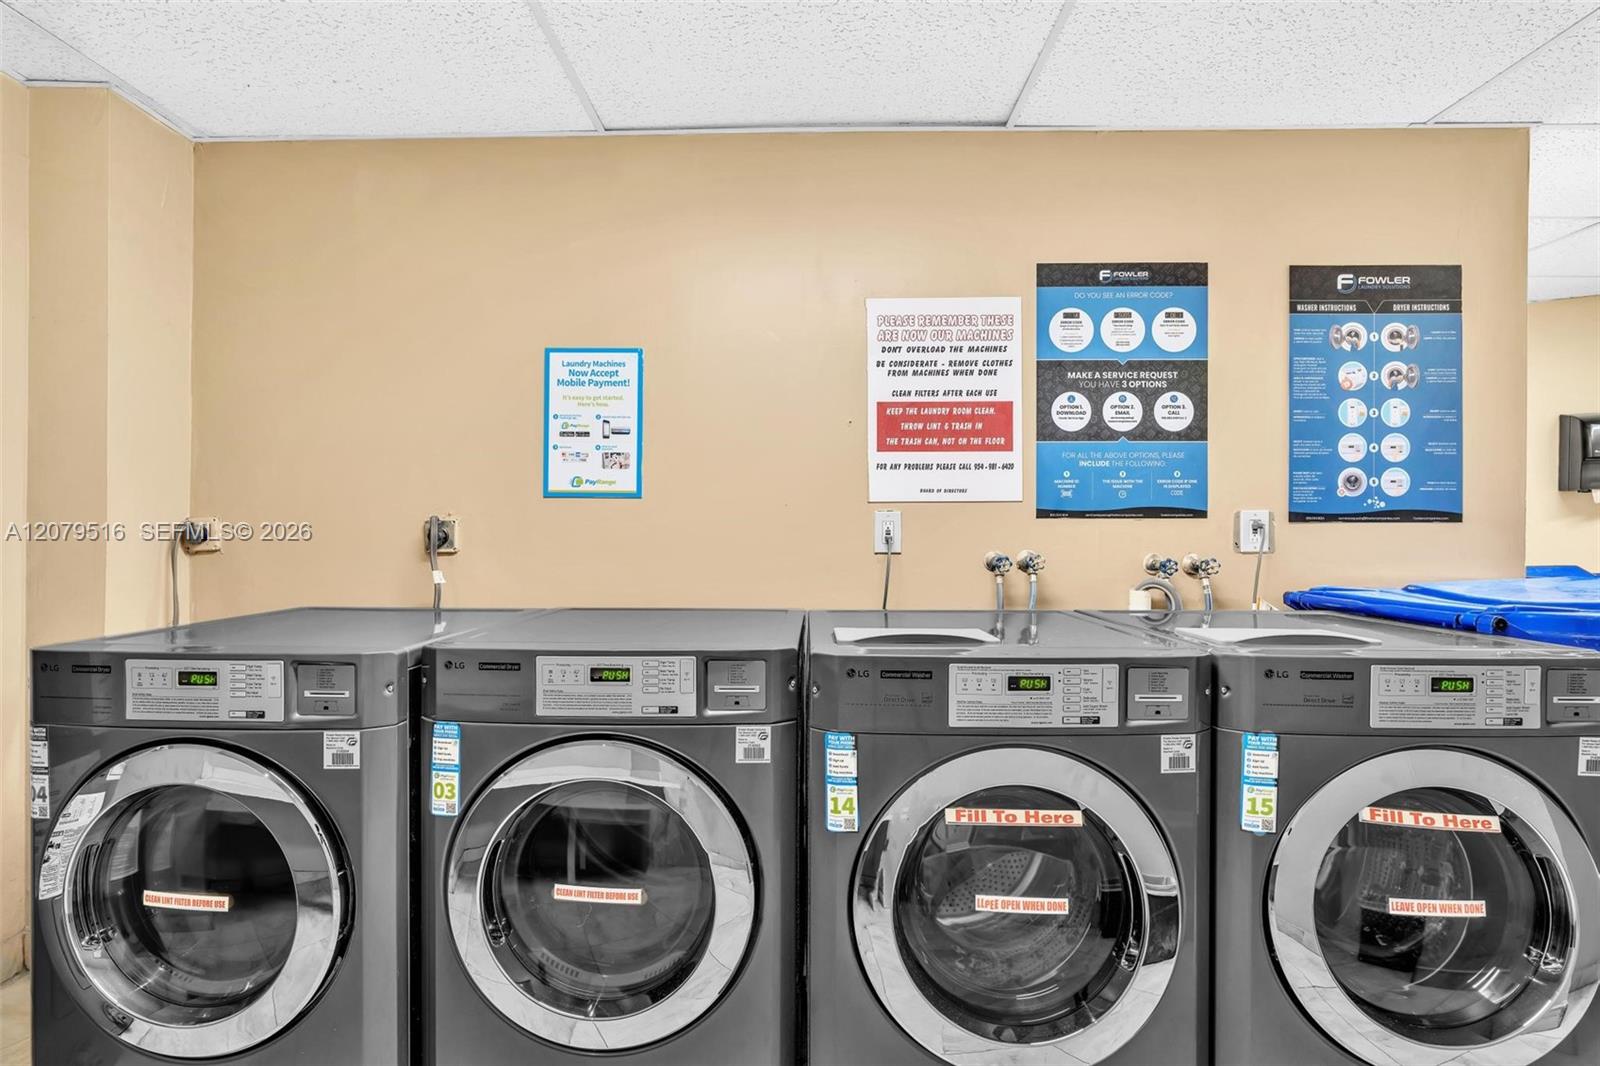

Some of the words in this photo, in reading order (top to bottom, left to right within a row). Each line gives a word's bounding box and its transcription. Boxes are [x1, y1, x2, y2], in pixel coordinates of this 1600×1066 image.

[877, 315, 915, 327] PLEASE
[917, 315, 978, 327] REMEMBER
[981, 315, 1014, 326] THESE
[877, 330, 898, 342] ARE
[901, 330, 927, 342] NOW
[930, 330, 953, 342] OUR
[956, 329, 1014, 341] MACHINES
[562, 360, 591, 368] Laundry
[590, 369, 619, 378] Accept
[588, 379, 630, 389] Payment!
[602, 670, 628, 680] PUSH
[1020, 679, 1047, 689] PUSH
[1441, 680, 1470, 691] PUSH
[434, 782, 456, 799] 03
[831, 797, 855, 815] 14
[1246, 797, 1274, 815] 15
[955, 809, 987, 822] Fill
[993, 810, 1017, 822] To
[1025, 811, 1074, 823] Here
[1369, 809, 1403, 823] Fill
[1410, 812, 1435, 826] To
[1443, 815, 1492, 829] Here
[556, 888, 573, 896] CLEAN
[145, 895, 161, 903] CLEAN
[174, 898, 191, 906] FILTER
[192, 899, 213, 908] BEFORE
[1001, 900, 1020, 910] OPEN
[1022, 901, 1045, 911] WHEN
[1047, 902, 1066, 911] DONE
[1391, 902, 1414, 912] LEAVE
[1417, 903, 1437, 913] OPEN
[1439, 904, 1462, 913] WHEN
[1464, 904, 1484, 914] DONE
